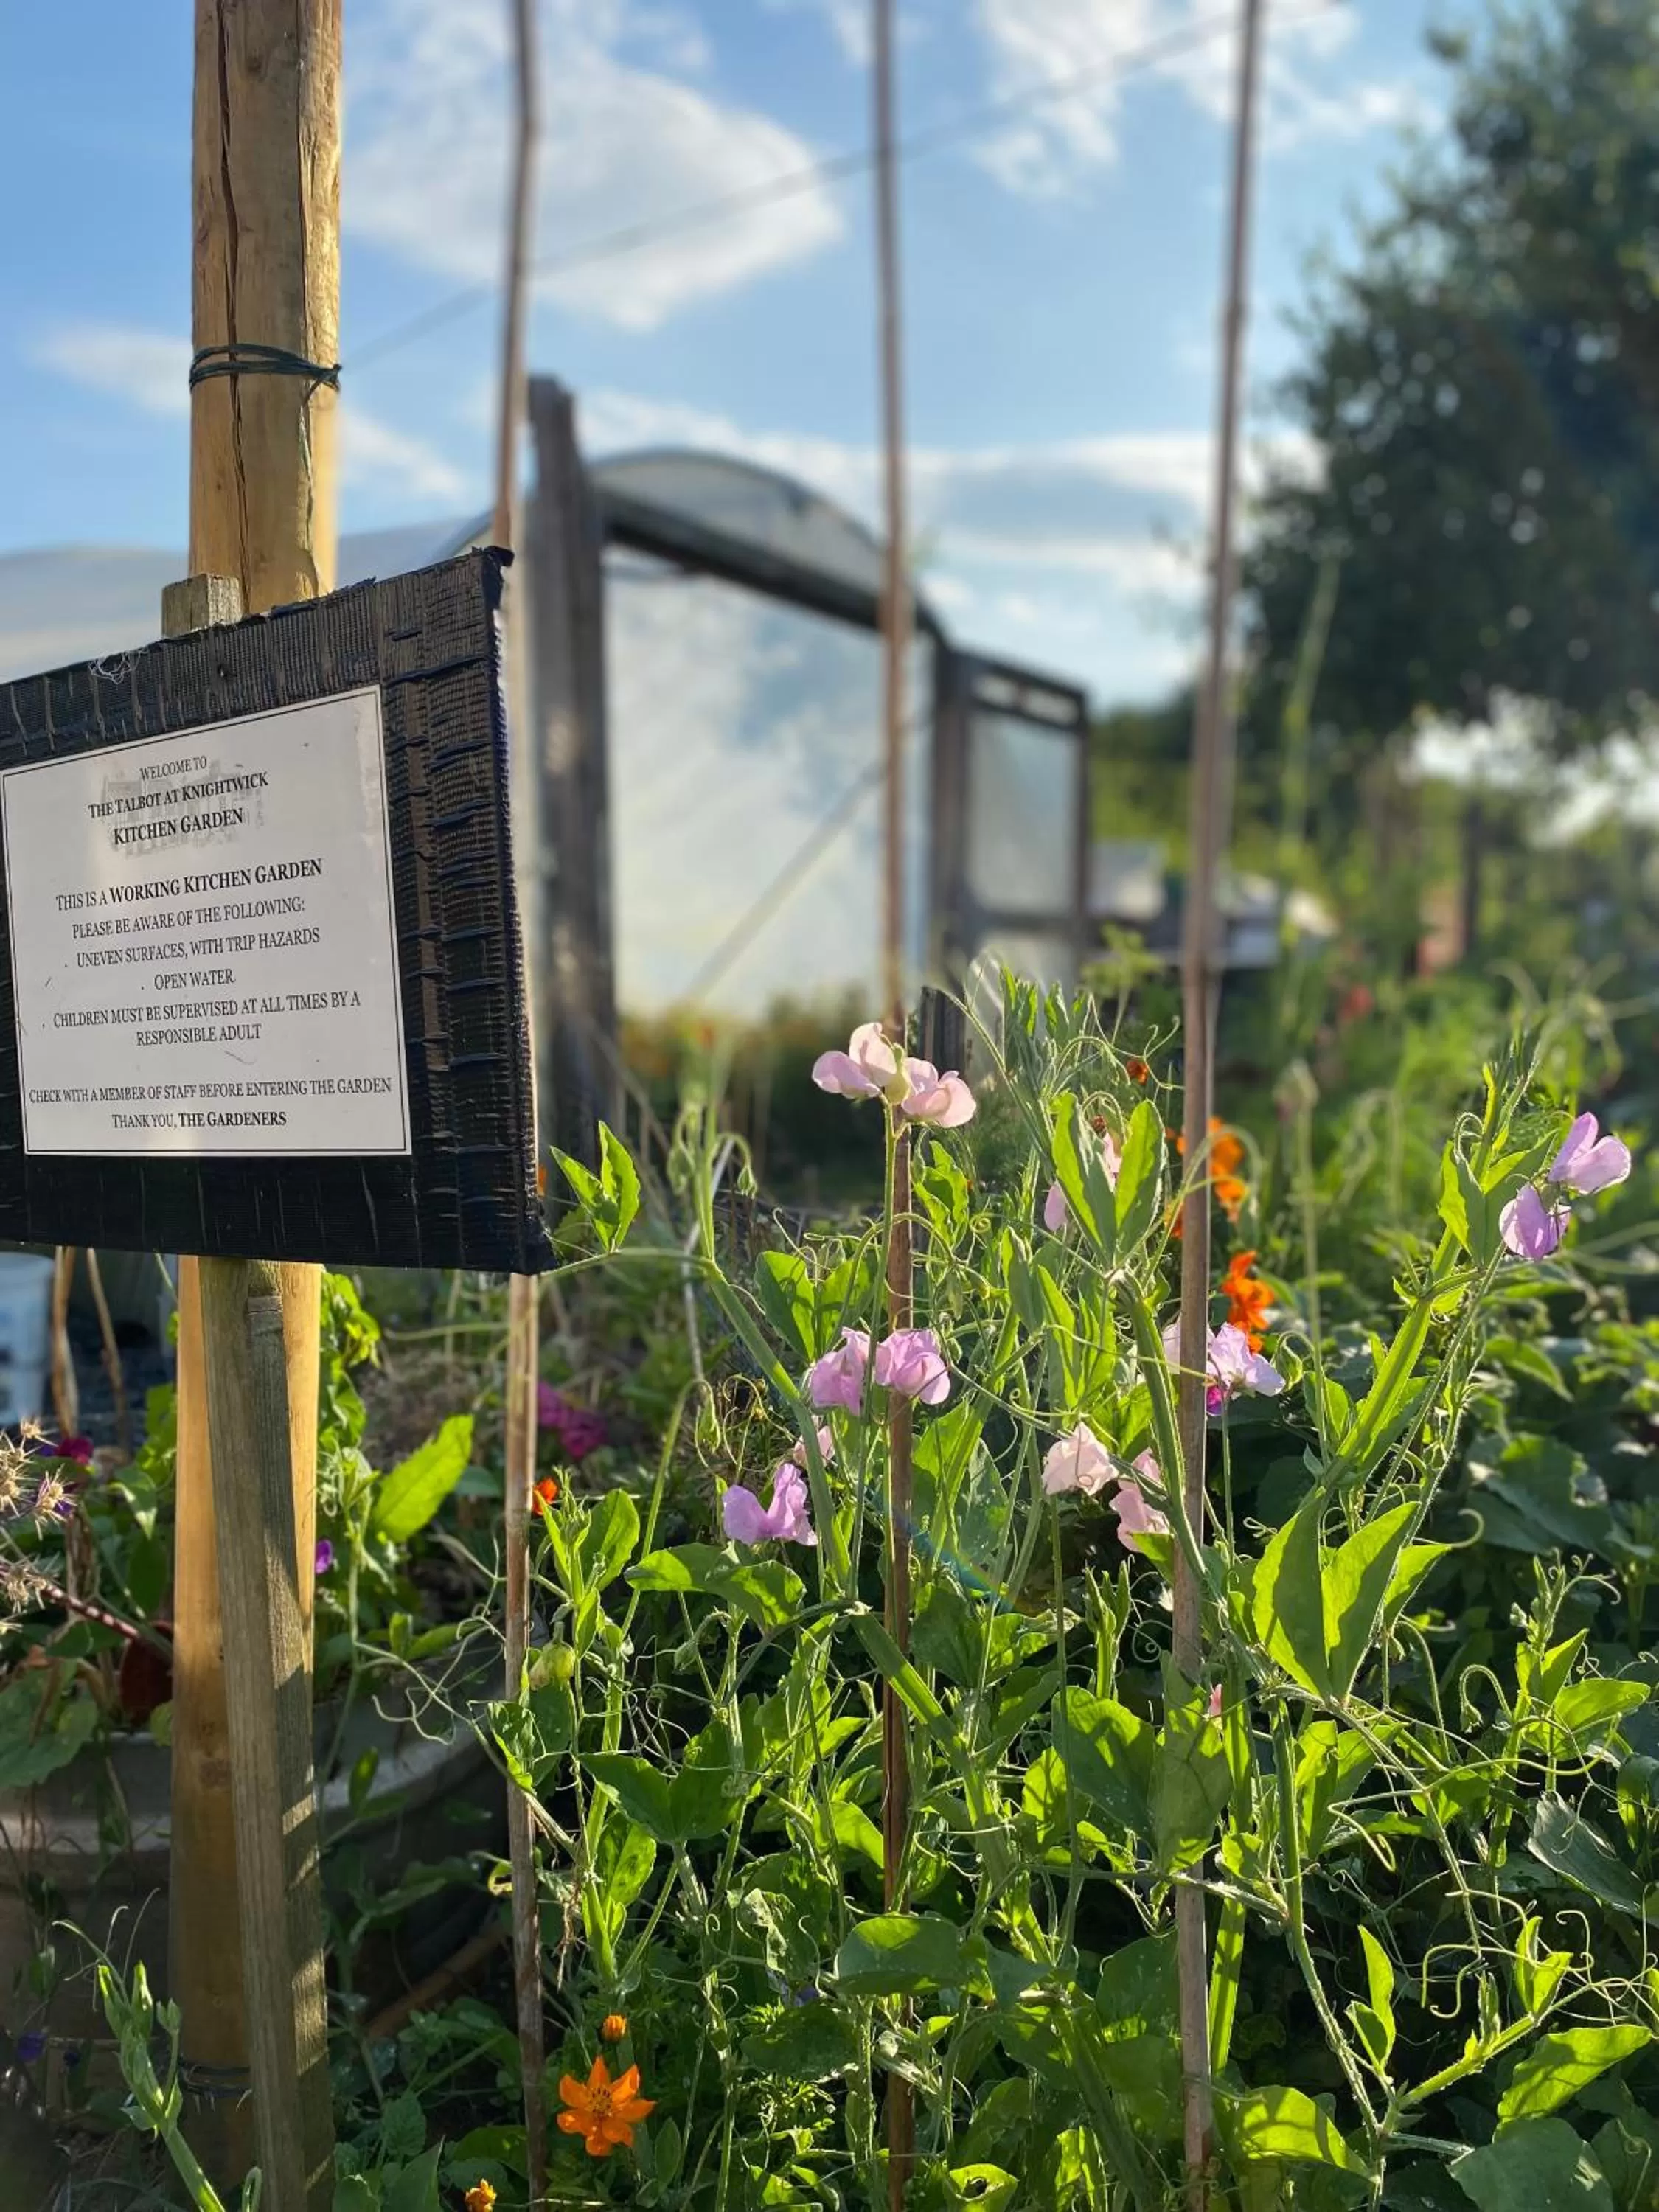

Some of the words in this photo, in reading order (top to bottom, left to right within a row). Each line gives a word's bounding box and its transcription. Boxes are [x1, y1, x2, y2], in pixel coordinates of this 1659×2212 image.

[140, 759, 192, 780] WELCOME
[193, 756, 207, 771] TO
[88, 801, 114, 818] THE
[115, 792, 161, 813] TALBOT
[164, 789, 180, 804] AT
[183, 771, 268, 801] KNIGHTWICK
[114, 820, 177, 845] KITCHEN
[181, 808, 243, 834] GARDEN
[56, 893, 83, 911] THIS
[86, 891, 97, 907] IS
[100, 890, 108, 905] A
[109, 879, 180, 903] WORKING
[184, 869, 251, 894] KITCHEN
[255, 858, 321, 884] GARDEN
[72, 921, 113, 939] PLEASE
[116, 918, 131, 933] BE
[133, 912, 175, 932] AWARE
[177, 910, 193, 926] OF
[195, 906, 221, 923] THE
[224, 896, 305, 920] FOLLOWING:
[77, 950, 123, 967] UNEVEN
[125, 942, 188, 962] SURFACES,
[190, 937, 223, 955] WITH
[226, 935, 256, 952] TRIP
[259, 928, 319, 948] HAZARDS
[154, 973, 187, 990] OPEN
[53, 1009, 108, 1028] CHILDREN
[111, 1007, 143, 1023] MUST
[146, 1006, 160, 1020] BE
[163, 1000, 238, 1020] SUPERVISED
[241, 998, 257, 1015] AT
[260, 997, 285, 1013] ALL
[286, 992, 328, 1011] TIMES
[330, 991, 348, 1008] BY
[350, 991, 361, 1006] A
[136, 1027, 217, 1046] RESPONSIBLE
[220, 1023, 262, 1041] ADULT
[29, 1089, 61, 1104] CHECK
[63, 1088, 88, 1102] WITH
[91, 1088, 98, 1101] A
[100, 1086, 146, 1101] MEMBER
[147, 1085, 161, 1099] OF
[164, 1085, 197, 1099] STAFF
[199, 1083, 243, 1098] BEFORE
[246, 1080, 307, 1096] ENTERING
[309, 1079, 335, 1094] THE
[337, 1077, 392, 1093] GARDEN
[111, 1114, 150, 1128] THANK
[151, 1113, 177, 1128] YOU,
[178, 1113, 205, 1127] THE
[207, 1111, 287, 1127] GARDENERS
